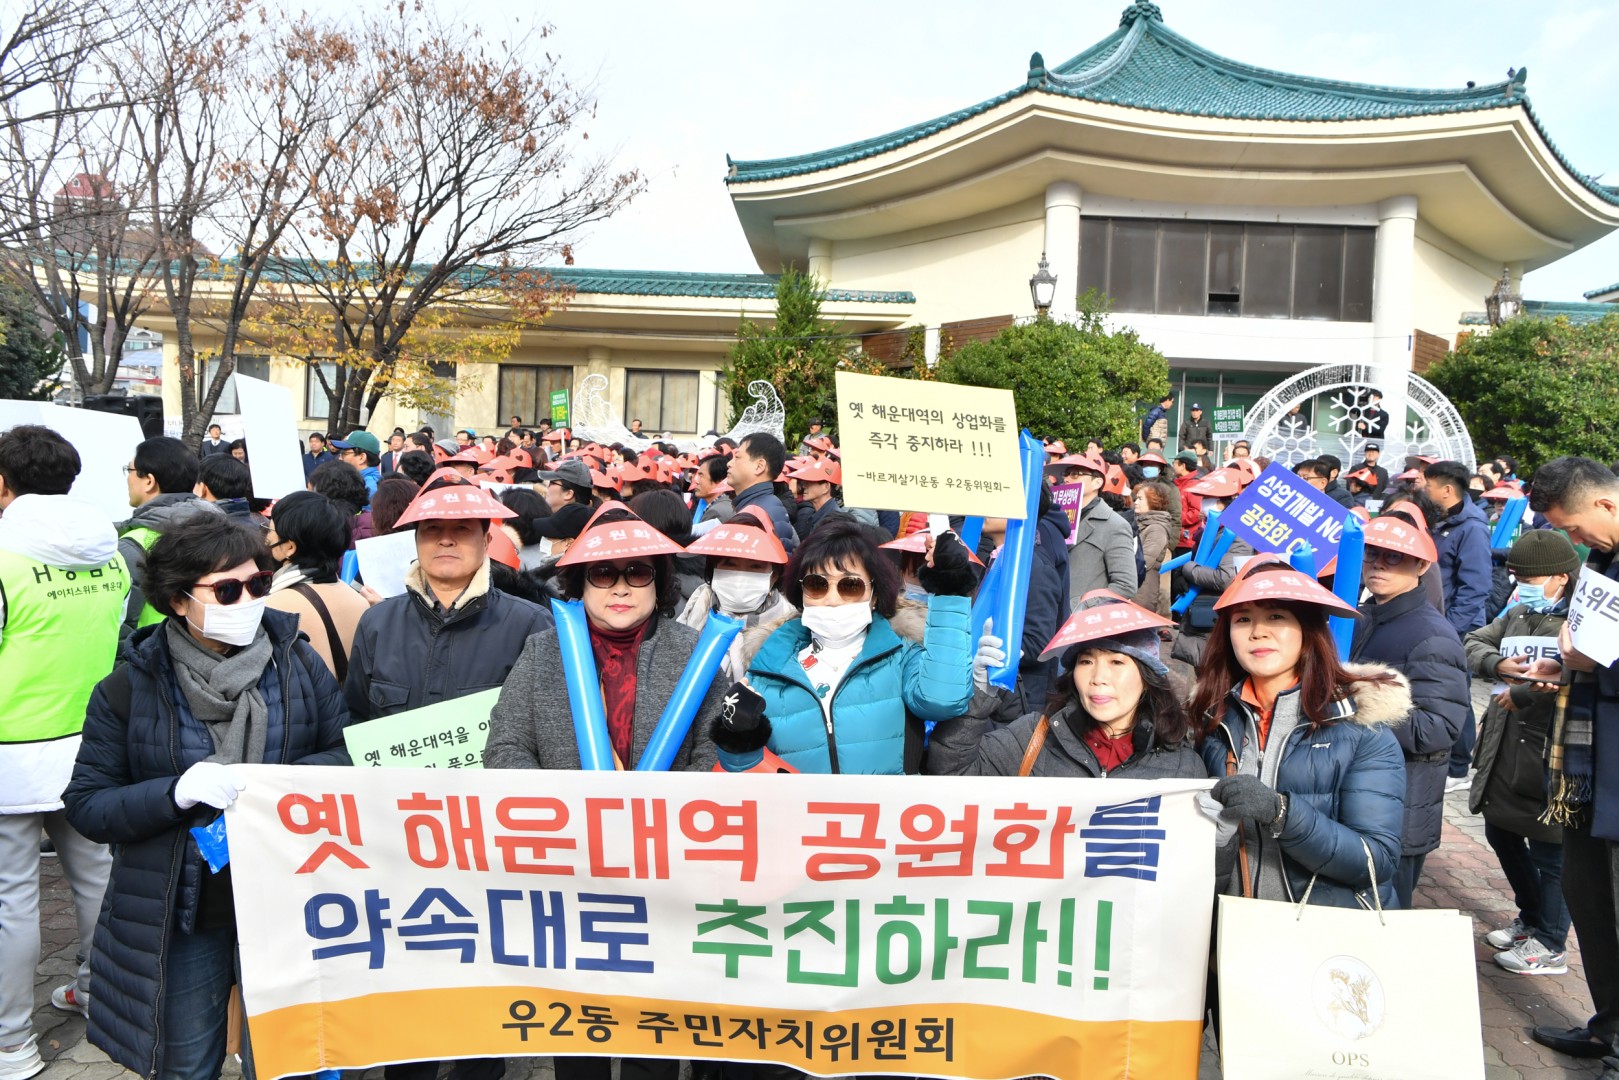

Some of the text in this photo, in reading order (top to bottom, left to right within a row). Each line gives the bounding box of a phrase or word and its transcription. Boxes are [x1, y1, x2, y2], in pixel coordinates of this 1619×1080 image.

[849, 402, 1006, 432] 옛 해운대역의 상업화를
[869, 432, 992, 457] 즉각 중지하라 !!!
[1258, 475, 1324, 527] 상업개발
[586, 528, 664, 549] 공원화!
[1240, 503, 1318, 555] 공원화 O
[1364, 522, 1415, 545] 원화!
[364, 750, 382, 767] 옛
[390, 726, 470, 758] 해운대역을
[277, 792, 1166, 882] 옛 해운대역 공원화를
[304, 887, 1113, 990] 약속대로 추진하라!!
[502, 1000, 954, 1062] 우2동 주민자치위원회
[1332, 1050, 1370, 1067] OPS
